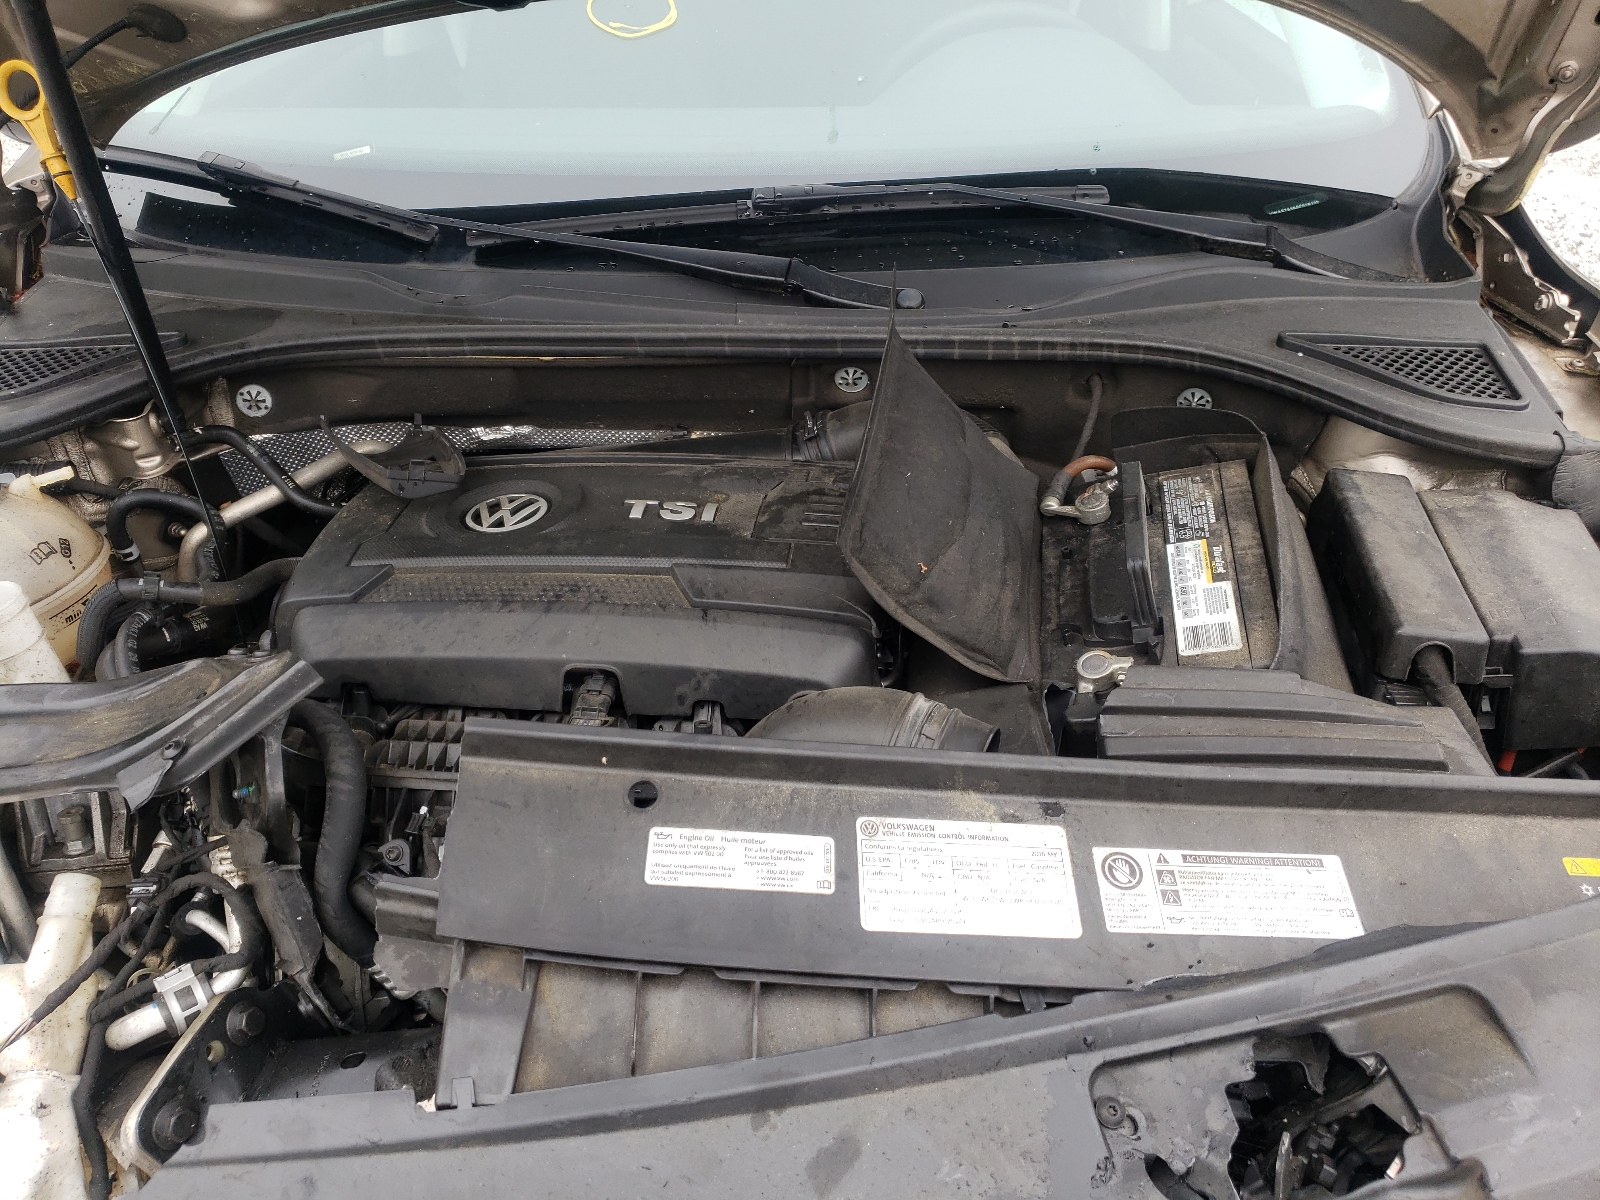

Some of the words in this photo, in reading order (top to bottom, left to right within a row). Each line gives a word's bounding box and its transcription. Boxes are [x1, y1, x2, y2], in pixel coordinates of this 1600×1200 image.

[624, 499, 719, 523] TSI
[65, 609, 82, 624] min
[882, 822, 935, 832] VOLKSWAGEN
[680, 834, 703, 842] Engine
[939, 832, 965, 840] CONTROL
[968, 834, 1009, 842] INFORMATION
[1186, 855, 1229, 864] ACHTUNG!
[1230, 857, 1273, 865] WARNING!
[1274, 858, 1321, 867] ATTENTION!
